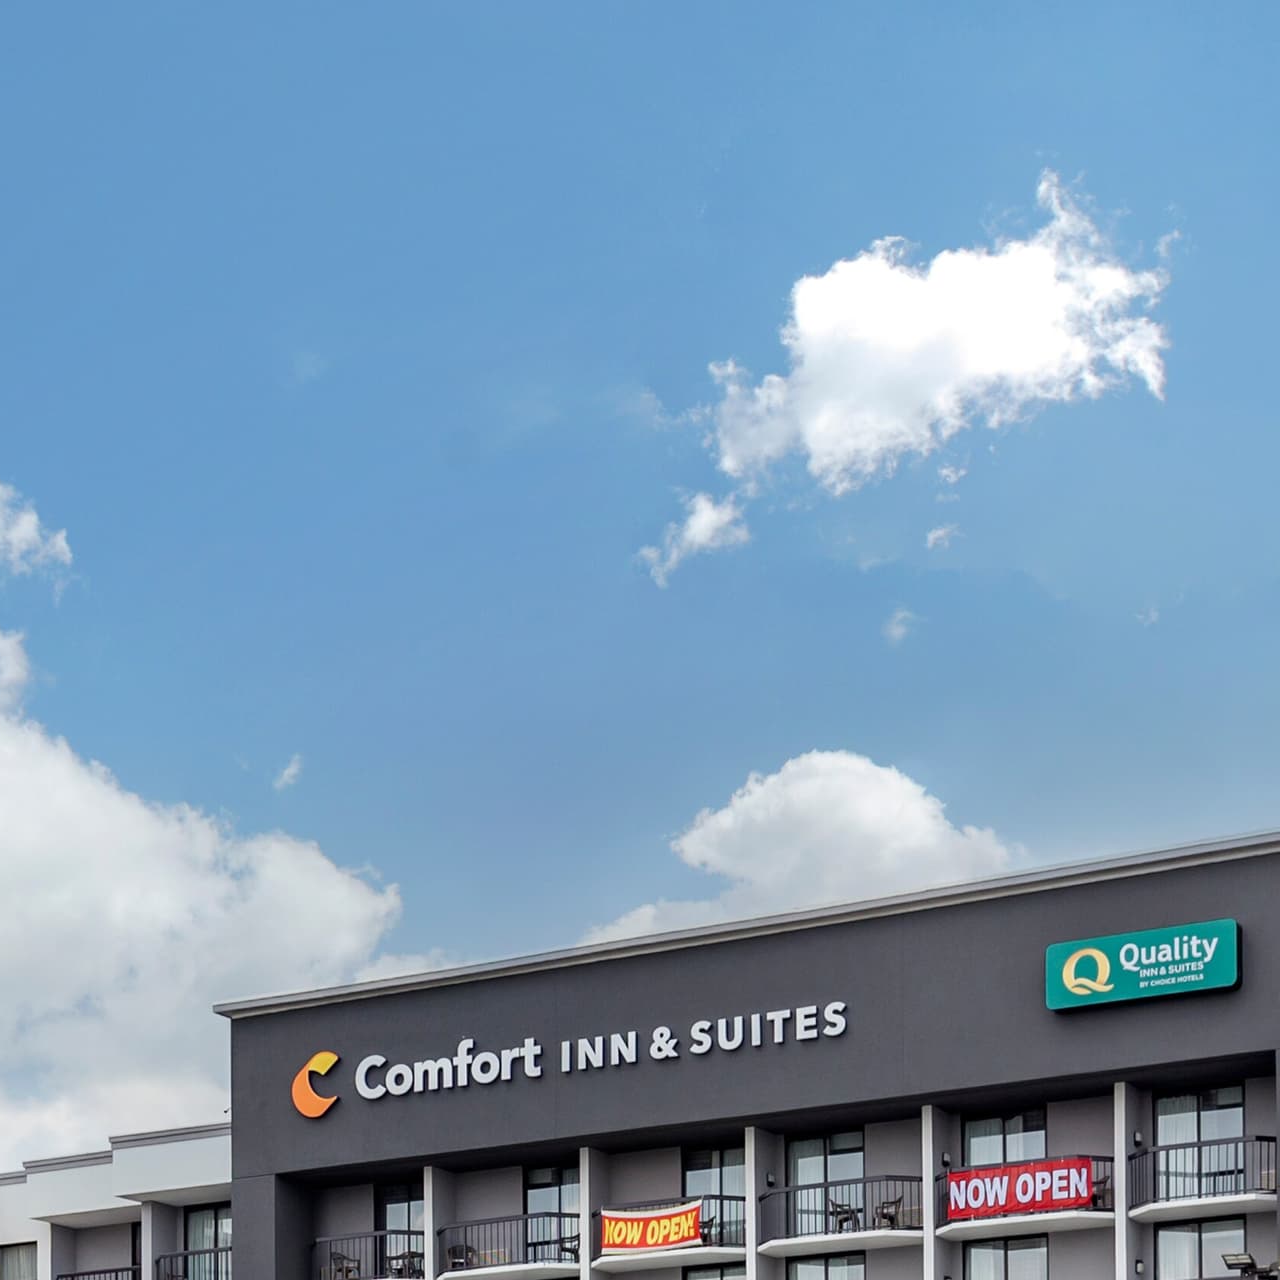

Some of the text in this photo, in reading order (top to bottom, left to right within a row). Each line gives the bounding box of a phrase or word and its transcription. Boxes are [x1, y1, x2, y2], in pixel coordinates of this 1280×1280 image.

[1119, 935, 1219, 972] Quality
[1139, 961, 1204, 978] INN & SUITES
[1139, 973, 1204, 988] BY CHOICE HOTELS
[354, 1001, 847, 1100] Comfort INN & SUITES
[950, 1167, 1088, 1211] NOW OPEN
[604, 1211, 697, 1246] NOW OPEN!
